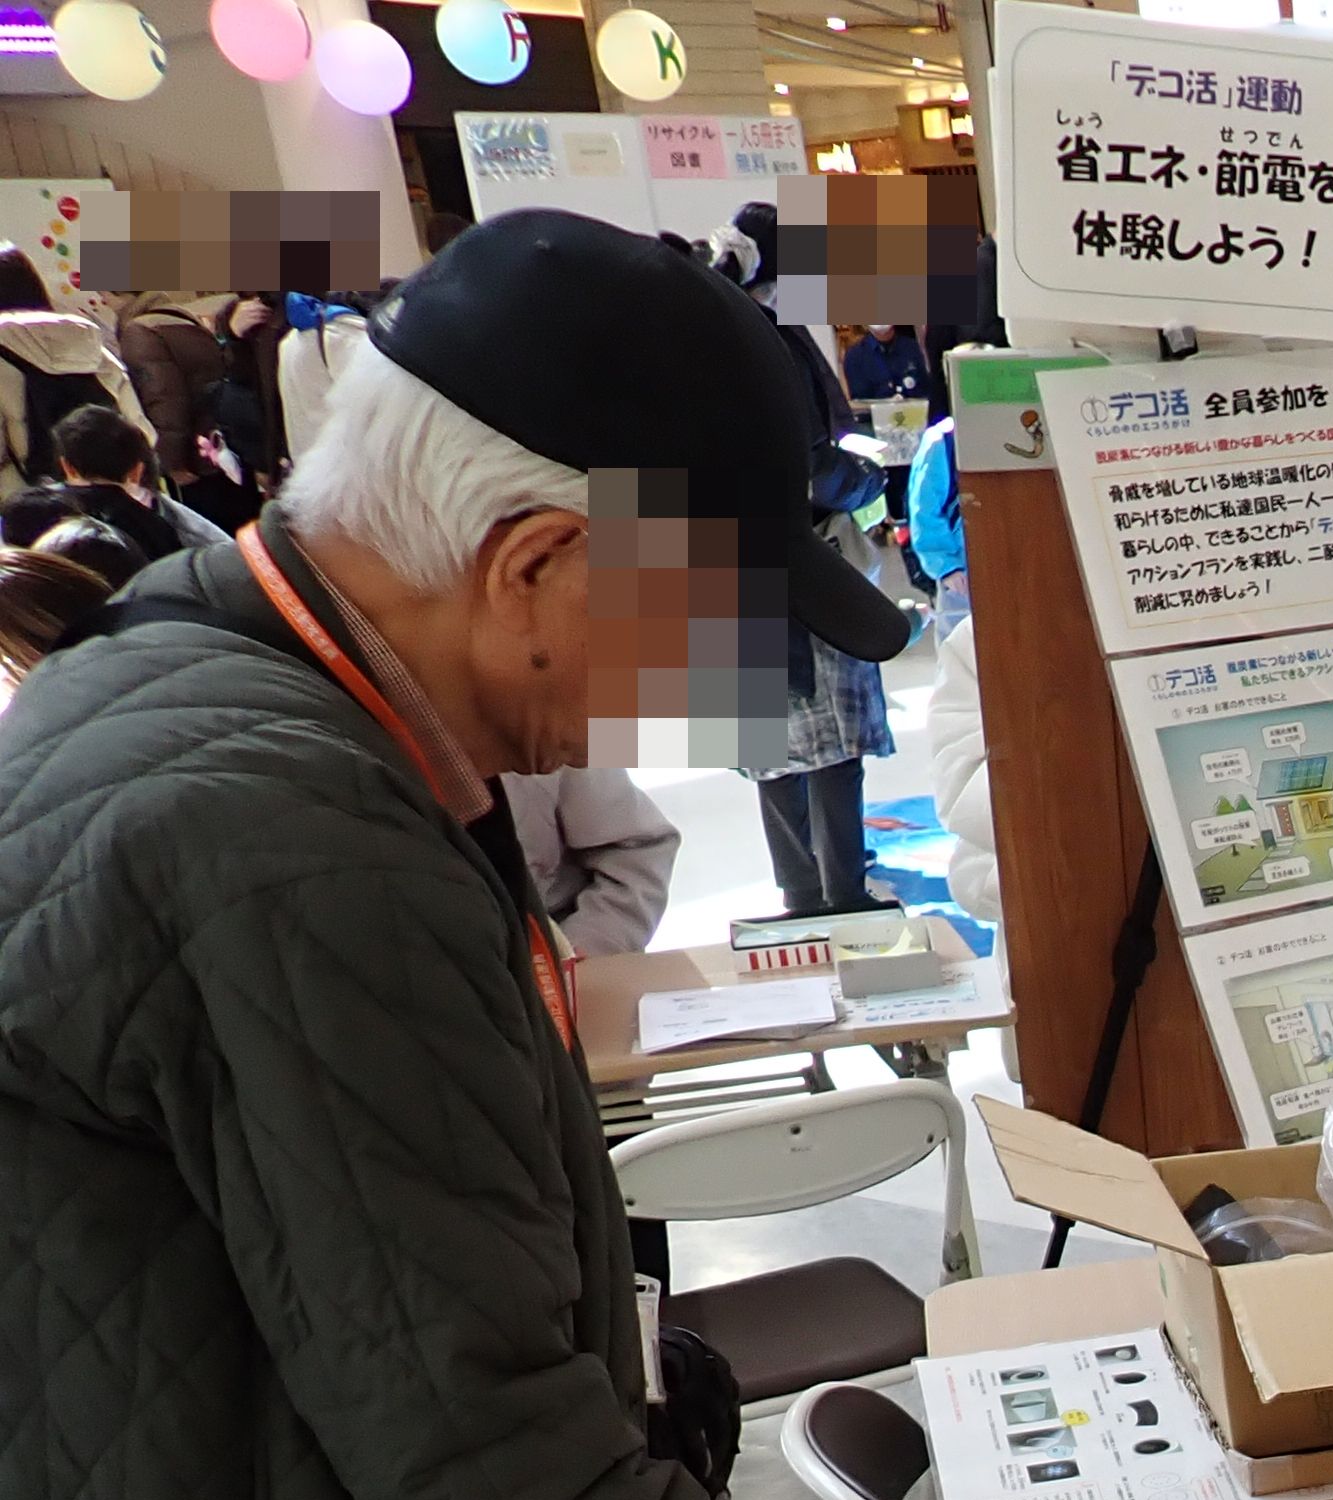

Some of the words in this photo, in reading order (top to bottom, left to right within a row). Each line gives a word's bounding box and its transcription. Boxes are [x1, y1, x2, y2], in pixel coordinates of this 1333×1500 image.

[650, 29, 685, 81] K
[1109, 59, 1303, 116] 「デコ活」運動
[647, 123, 717, 141] リサイクル
[1056, 108, 1104, 129] しょう
[1071, 209, 1318, 270] 体験しよう！
[1108, 388, 1190, 422] デコ活
[1165, 664, 1217, 690] デコ活
